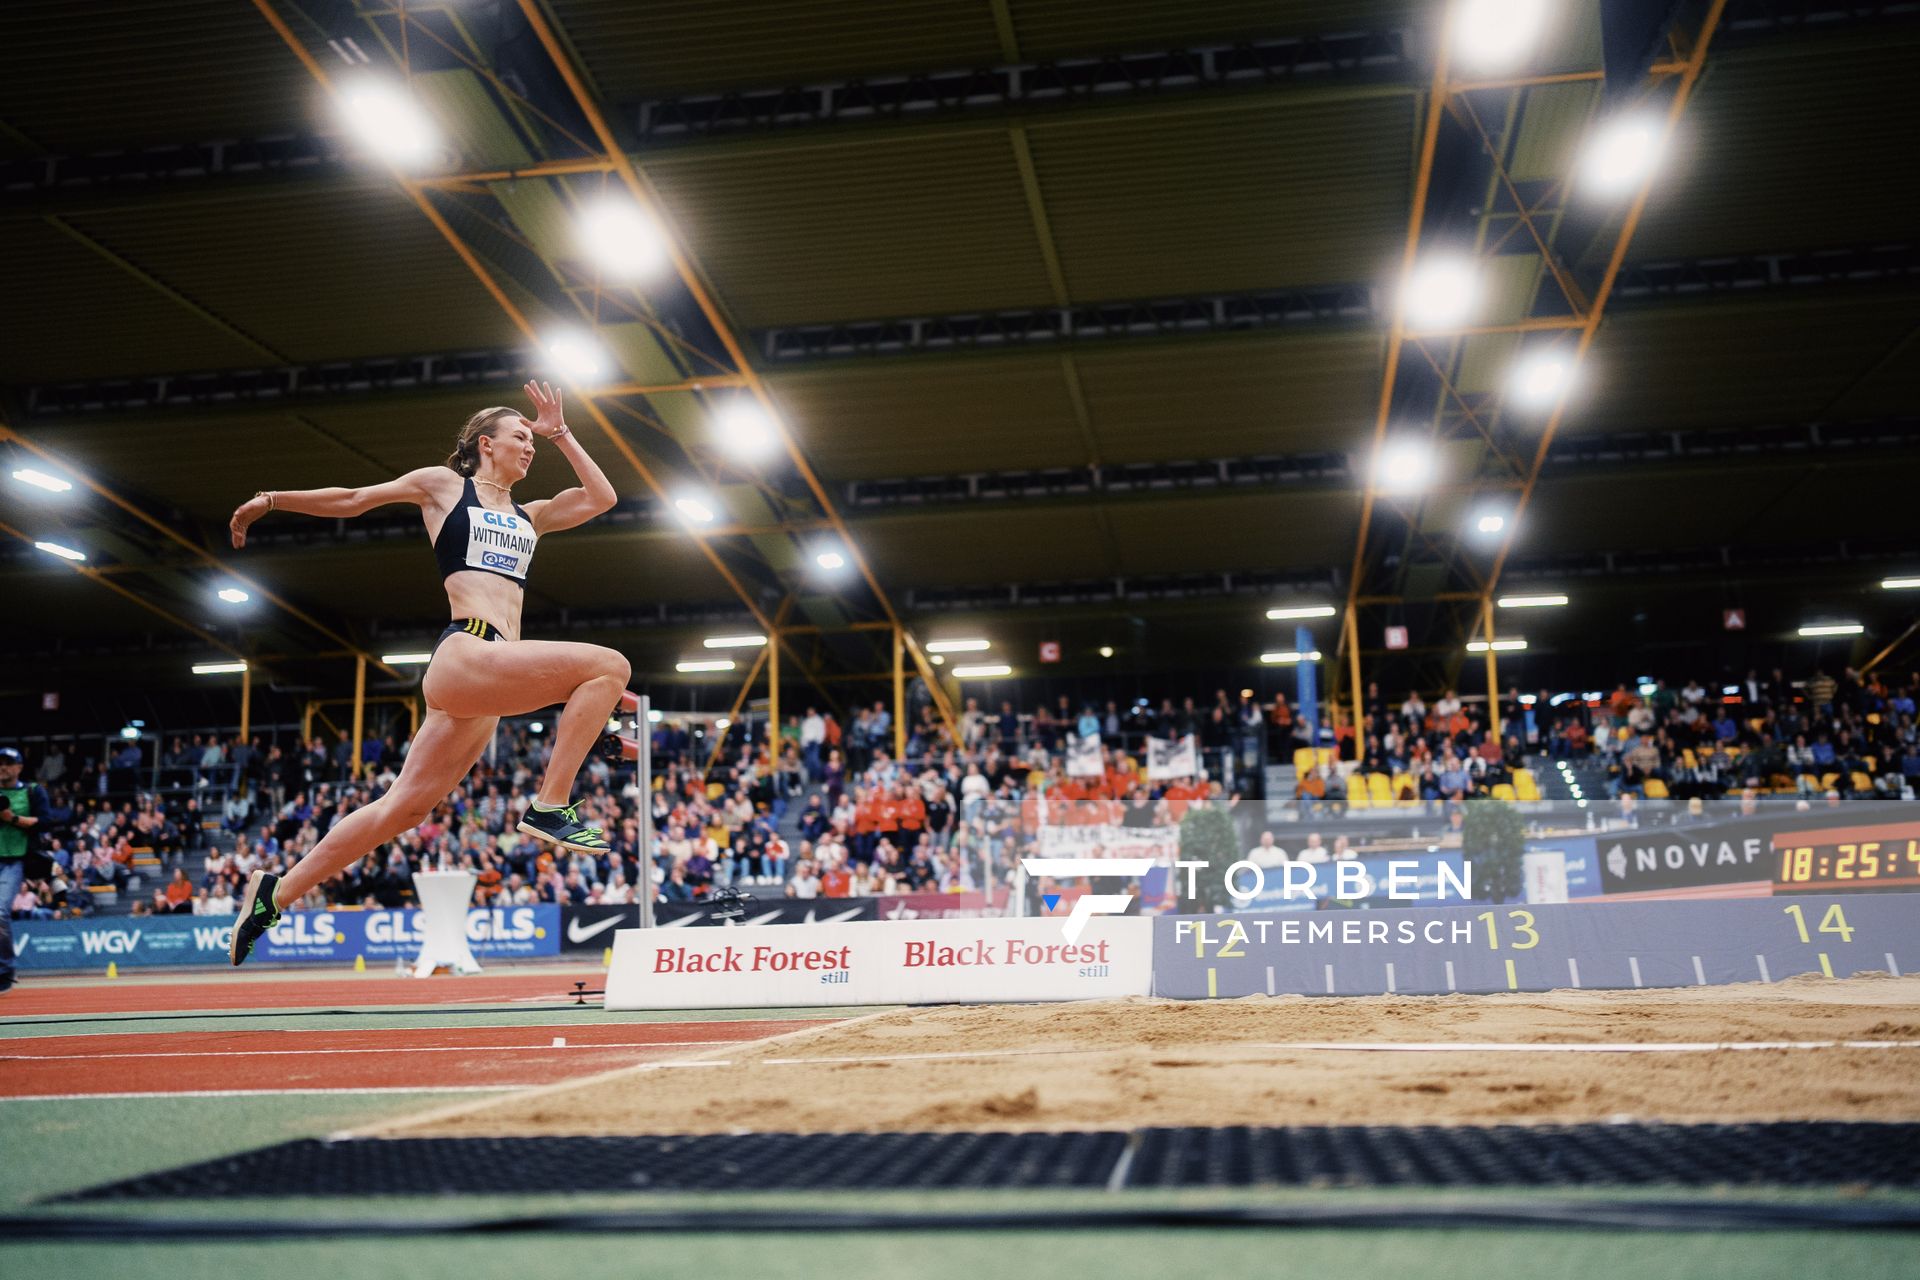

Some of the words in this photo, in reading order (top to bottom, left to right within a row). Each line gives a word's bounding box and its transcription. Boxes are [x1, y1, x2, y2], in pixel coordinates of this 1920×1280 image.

[473, 526, 534, 555] WITTMANN
[499, 556, 517, 567] PLAN
[1635, 838, 1774, 872] NOVAF
[193, 926, 232, 950] WG
[1477, 910, 1540, 950] 13
[1784, 904, 1855, 944] 14
[82, 929, 141, 954] WGV
[903, 939, 996, 967] Black
[1004, 939, 1110, 965] Forest
[1188, 919, 1246, 959] 12
[653, 946, 744, 974] Black
[751, 946, 851, 972] Forest
[1079, 965, 1109, 978] still
[820, 971, 849, 984] still
